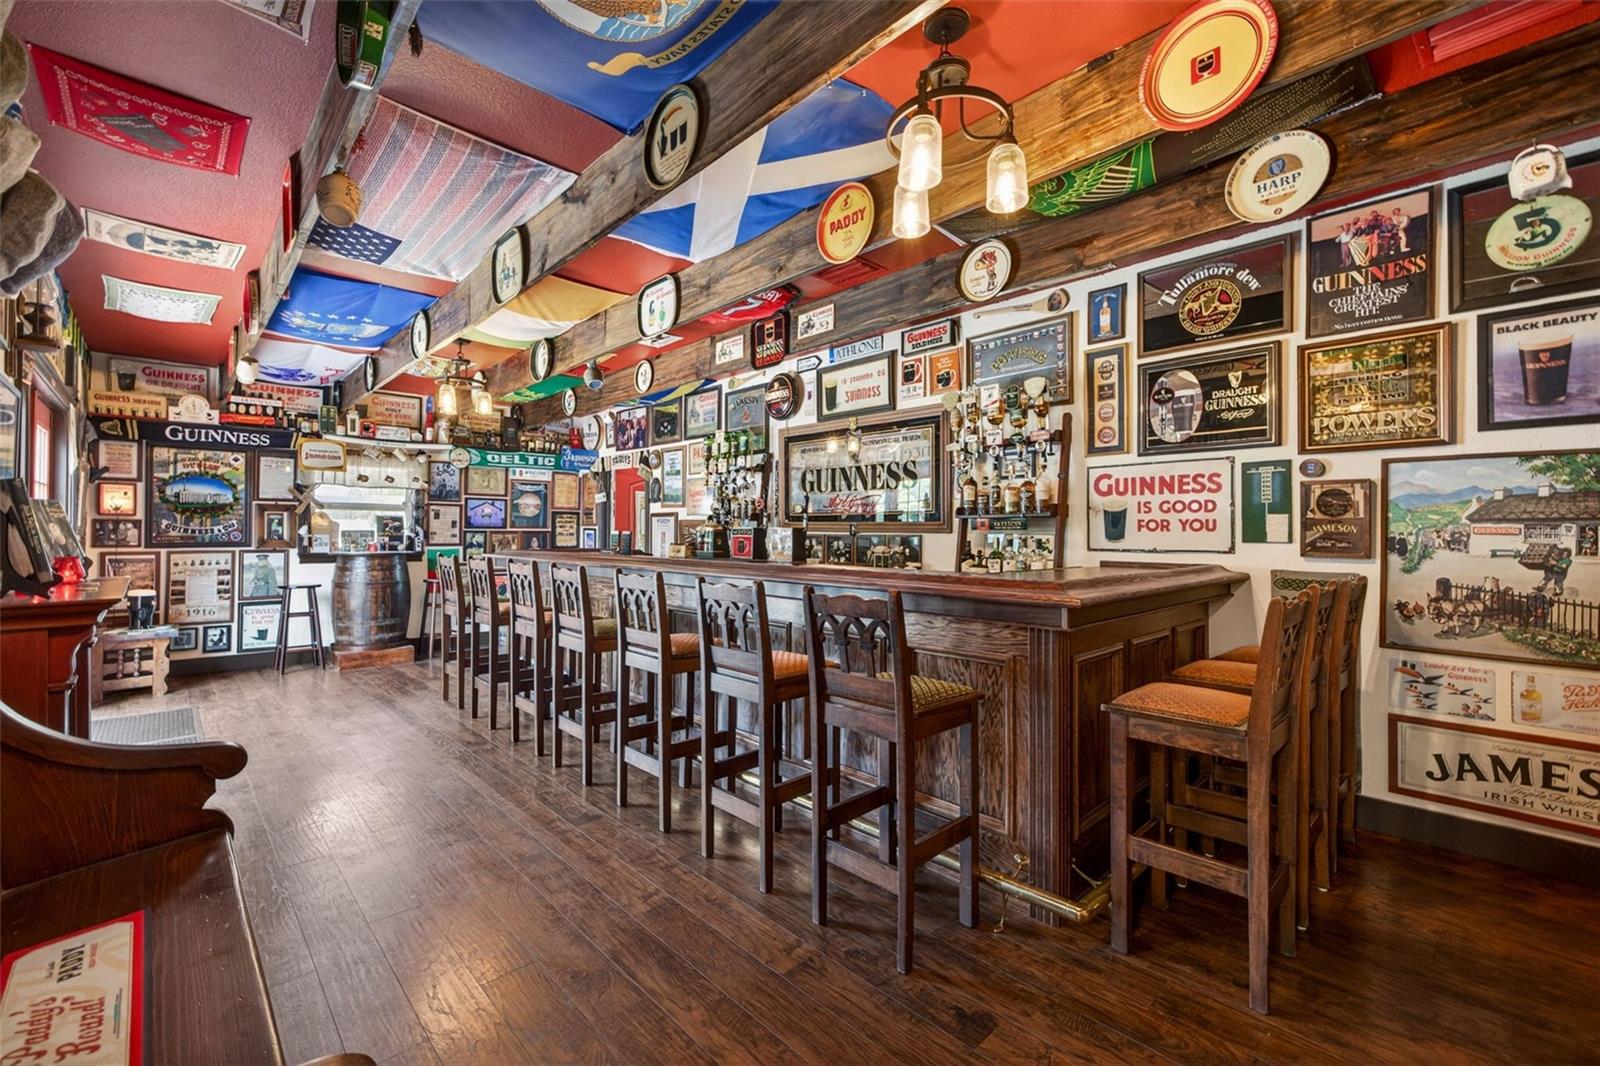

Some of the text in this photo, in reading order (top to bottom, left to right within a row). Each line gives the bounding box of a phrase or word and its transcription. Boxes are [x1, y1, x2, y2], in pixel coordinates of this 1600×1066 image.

[1256, 172, 1302, 194] HARP
[829, 206, 867, 235] PADDY
[1513, 206, 1562, 249] 5
[1534, 226, 1577, 260] GUINNESS
[1312, 254, 1427, 293] GUINNESS
[1157, 265, 1262, 307] Tullamore dew
[1352, 282, 1381, 296] THE
[1496, 312, 1598, 335] BLACK BEAUTY
[907, 325, 948, 344] GUINNESS
[836, 338, 881, 360] ATHLONE
[141, 366, 206, 383] GUINNESS
[94, 392, 131, 403] GUINNESS
[245, 382, 320, 398] GUINNESS
[1212, 385, 1259, 399] DRAUGHT
[371, 396, 417, 411] GUINNESS
[1204, 394, 1267, 411] GUINNESS
[164, 425, 271, 446] GUINNESS
[486, 454, 556, 466] CELTIC
[800, 460, 918, 493] GUINNESS
[1093, 471, 1223, 497] GUINNESS
[1136, 499, 1218, 514] IS GOOD
[1136, 518, 1218, 533] FOR YOU
[1311, 524, 1360, 534] JAMESON
[186, 608, 217, 617] 1916
[1484, 791, 1534, 808] IRISH
[57, 944, 86, 984] PADDY
